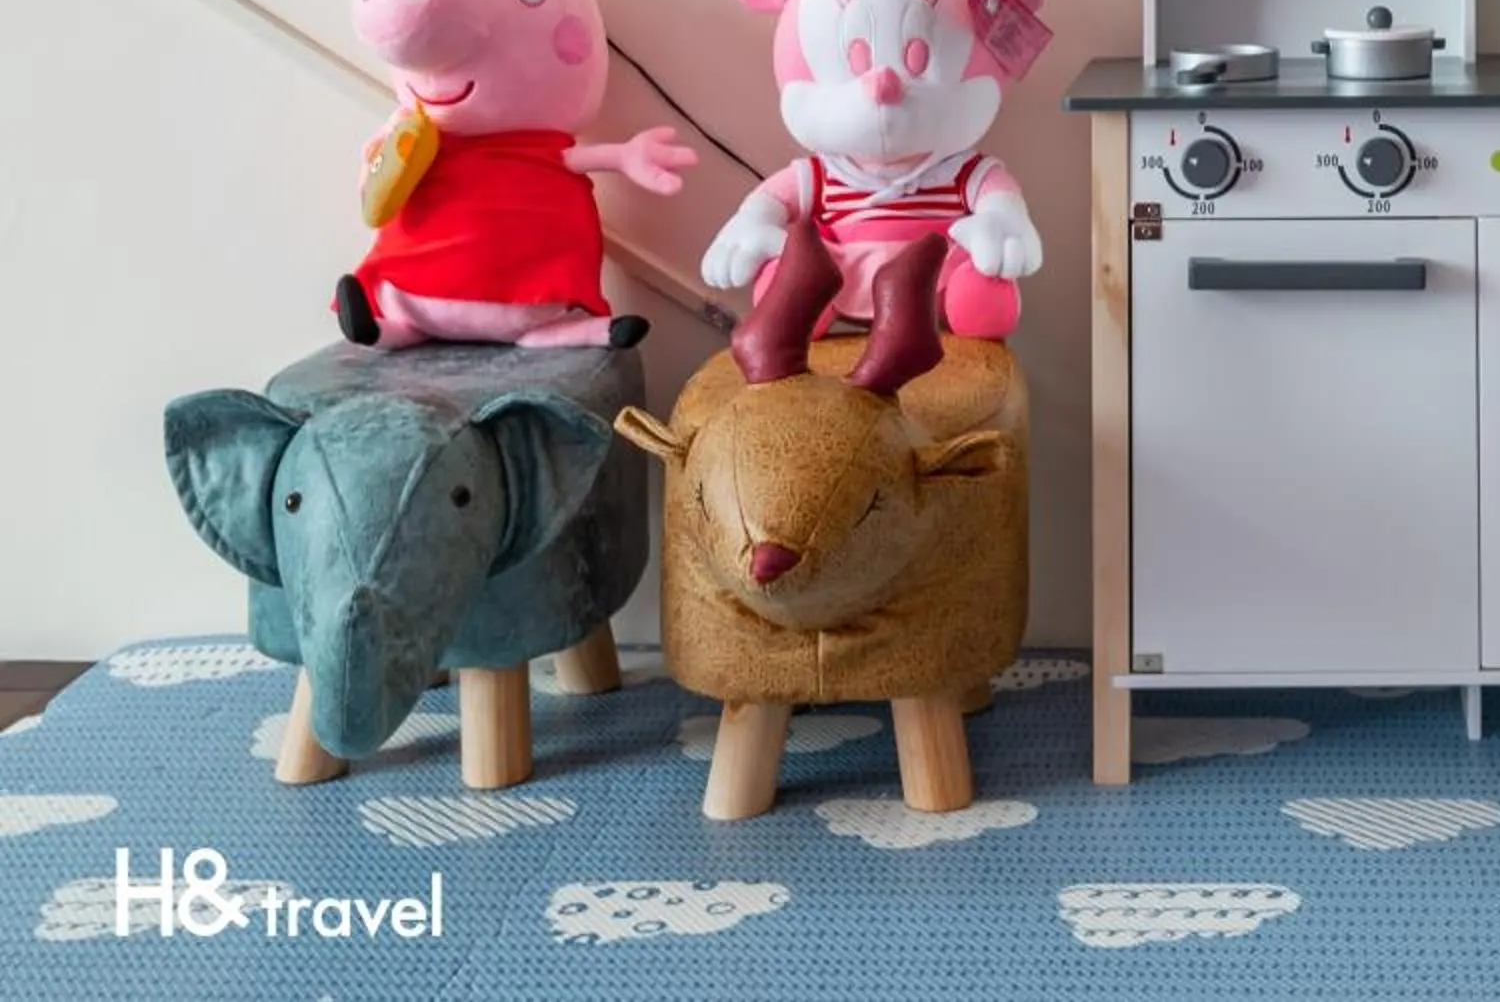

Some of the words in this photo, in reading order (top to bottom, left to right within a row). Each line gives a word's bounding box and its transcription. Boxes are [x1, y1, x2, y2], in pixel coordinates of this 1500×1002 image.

[1372, 109, 1381, 123] 0
[1141, 156, 1164, 169] 300
[1242, 159, 1264, 172] 100
[1316, 154, 1339, 167] 300
[1416, 157, 1438, 170] 100
[1192, 201, 1215, 215] 200
[1367, 199, 1391, 213] 200
